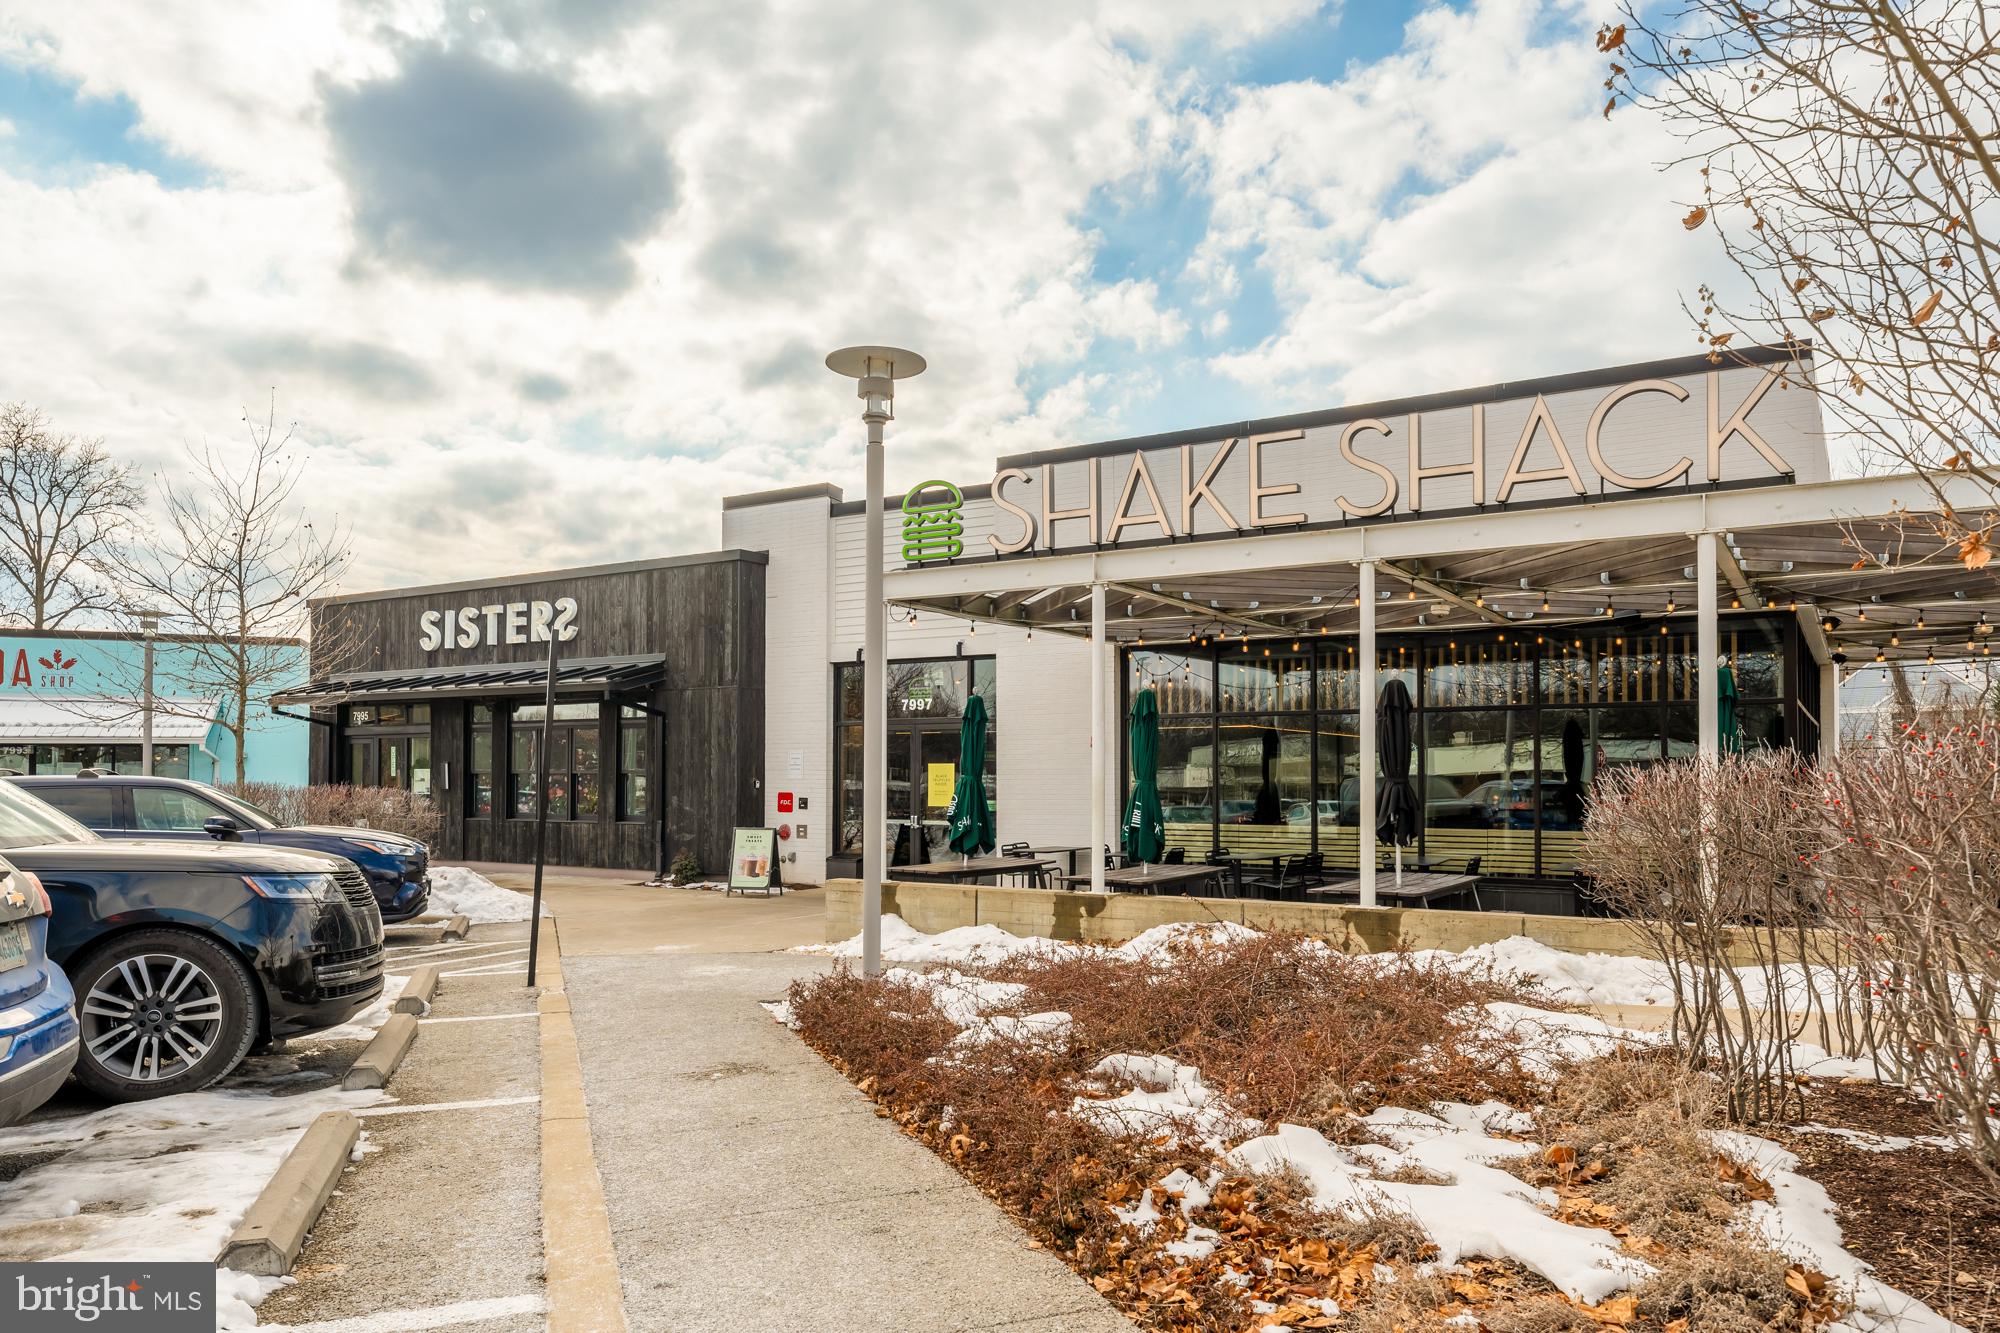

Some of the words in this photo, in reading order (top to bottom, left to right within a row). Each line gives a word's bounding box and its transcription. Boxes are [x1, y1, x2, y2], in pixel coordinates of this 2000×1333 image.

[986, 428, 1309, 555] SHAKE
[1334, 361, 1796, 519] SHACK
[419, 597, 579, 652] SISTERS
[0, 648, 33, 687] A
[41, 675, 74, 688] SHOP
[353, 711, 369, 721] 7995
[901, 699, 932, 711] 7997
